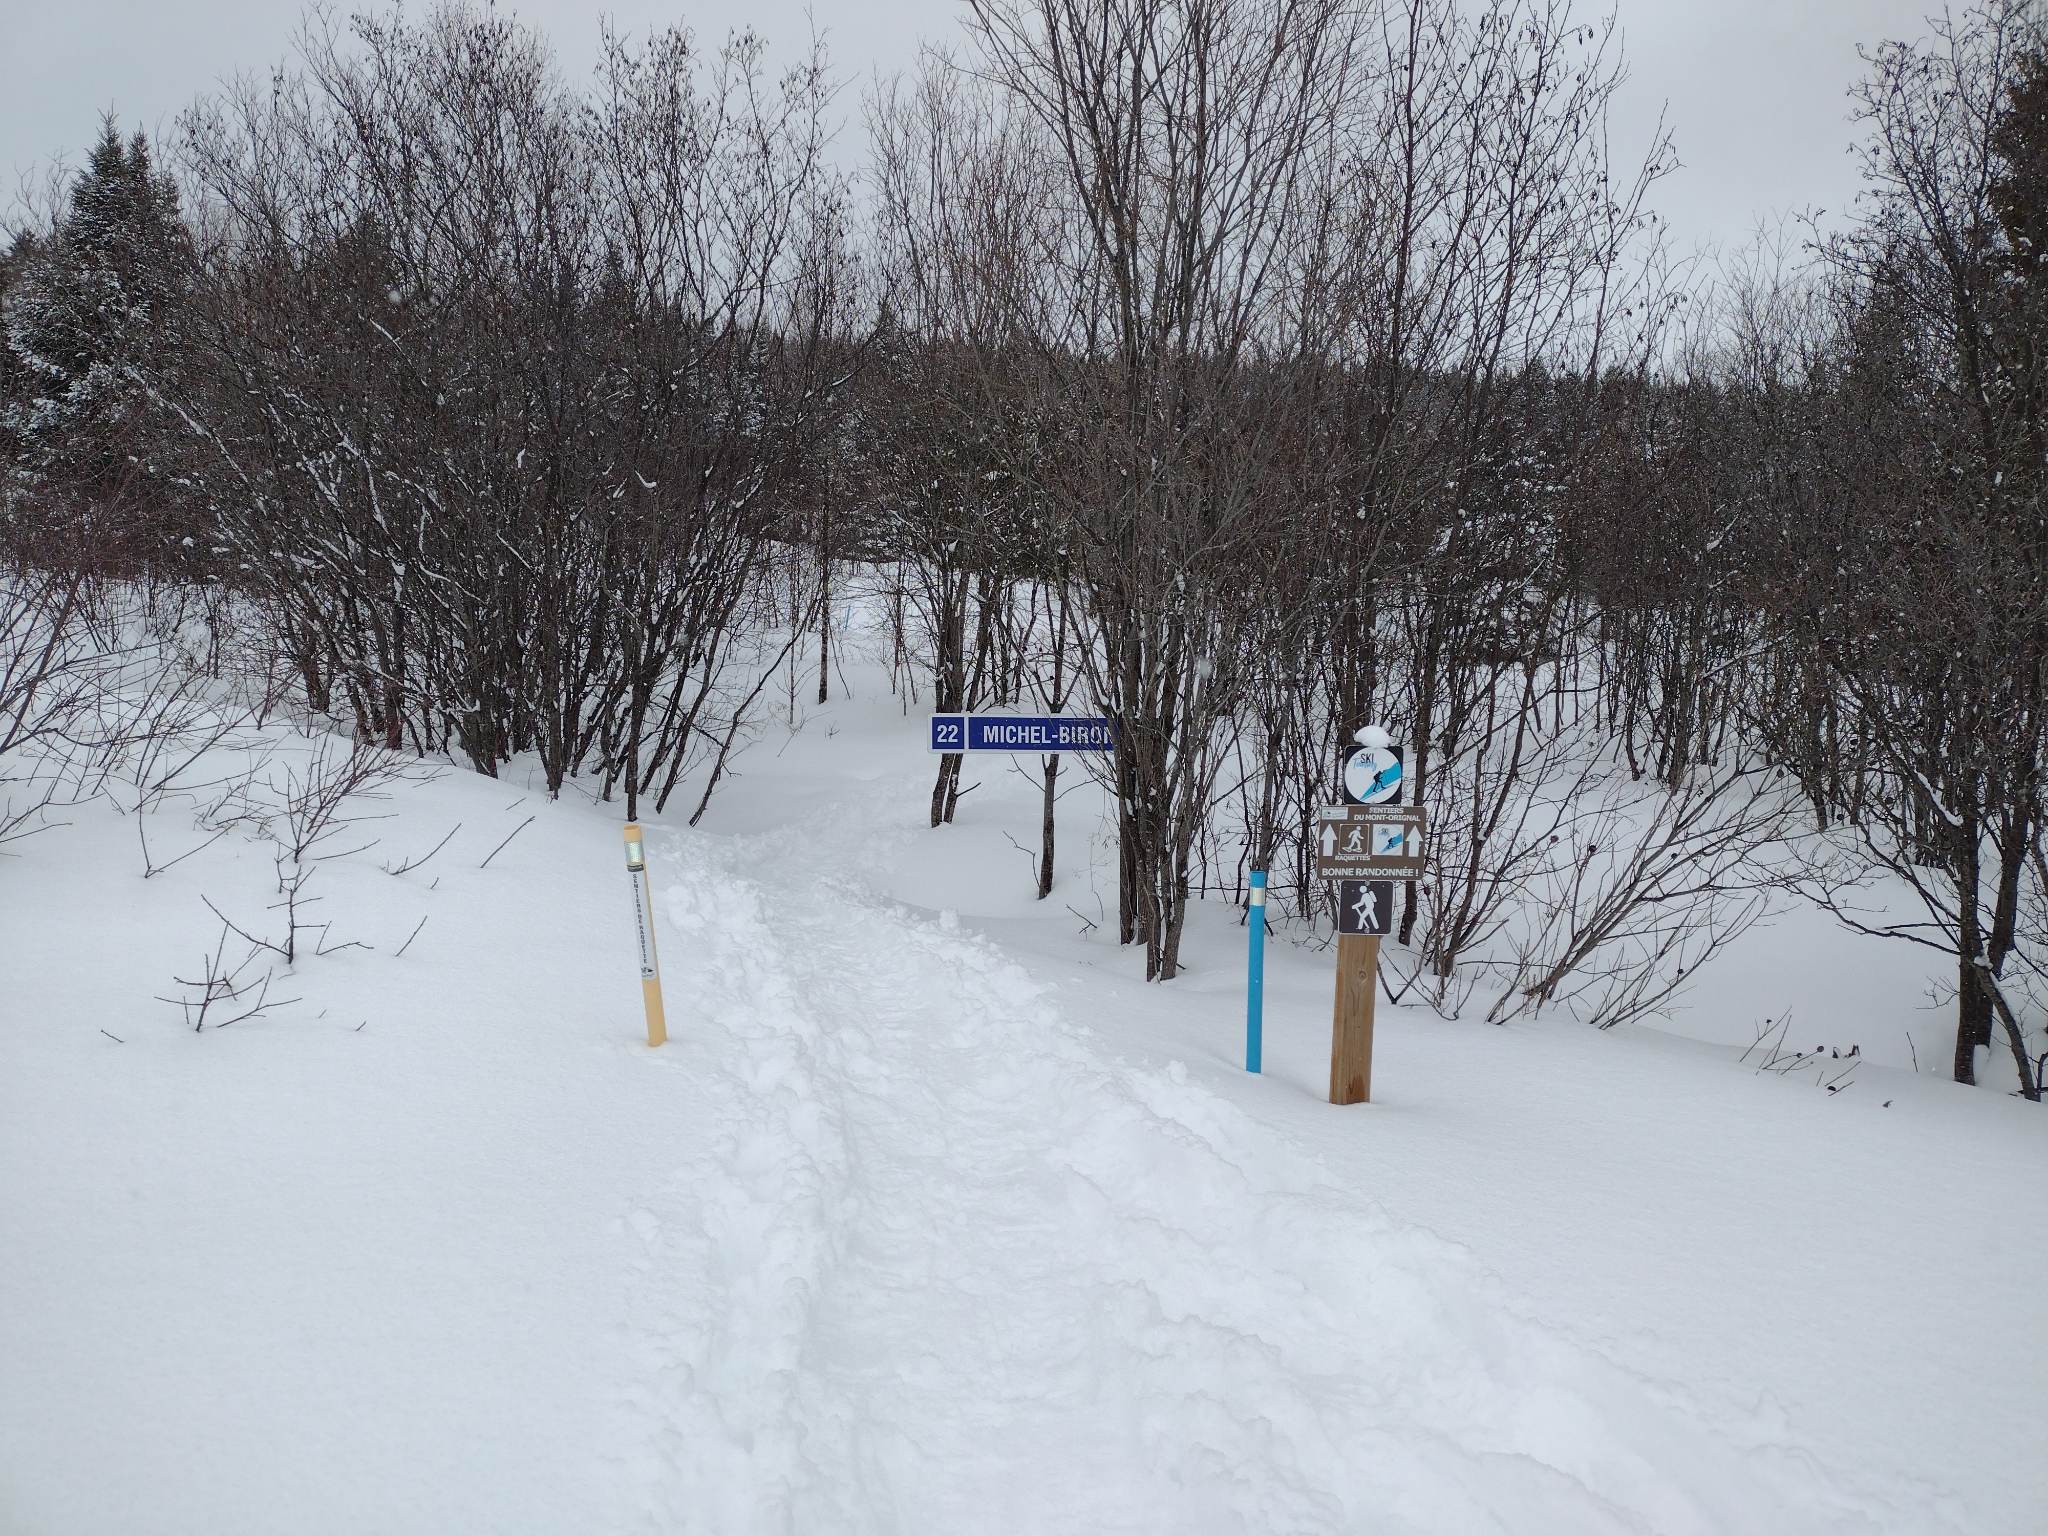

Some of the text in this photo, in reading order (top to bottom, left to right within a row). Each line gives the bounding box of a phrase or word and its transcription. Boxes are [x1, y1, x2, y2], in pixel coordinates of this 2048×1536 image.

[937, 724, 958, 743] 22
[1360, 753, 1374, 764] SKI
[1365, 814, 1421, 822] MONT-ORIGNAL
[1321, 867, 1354, 876] BONNE
[1355, 866, 1414, 877] RANDONNÉE
